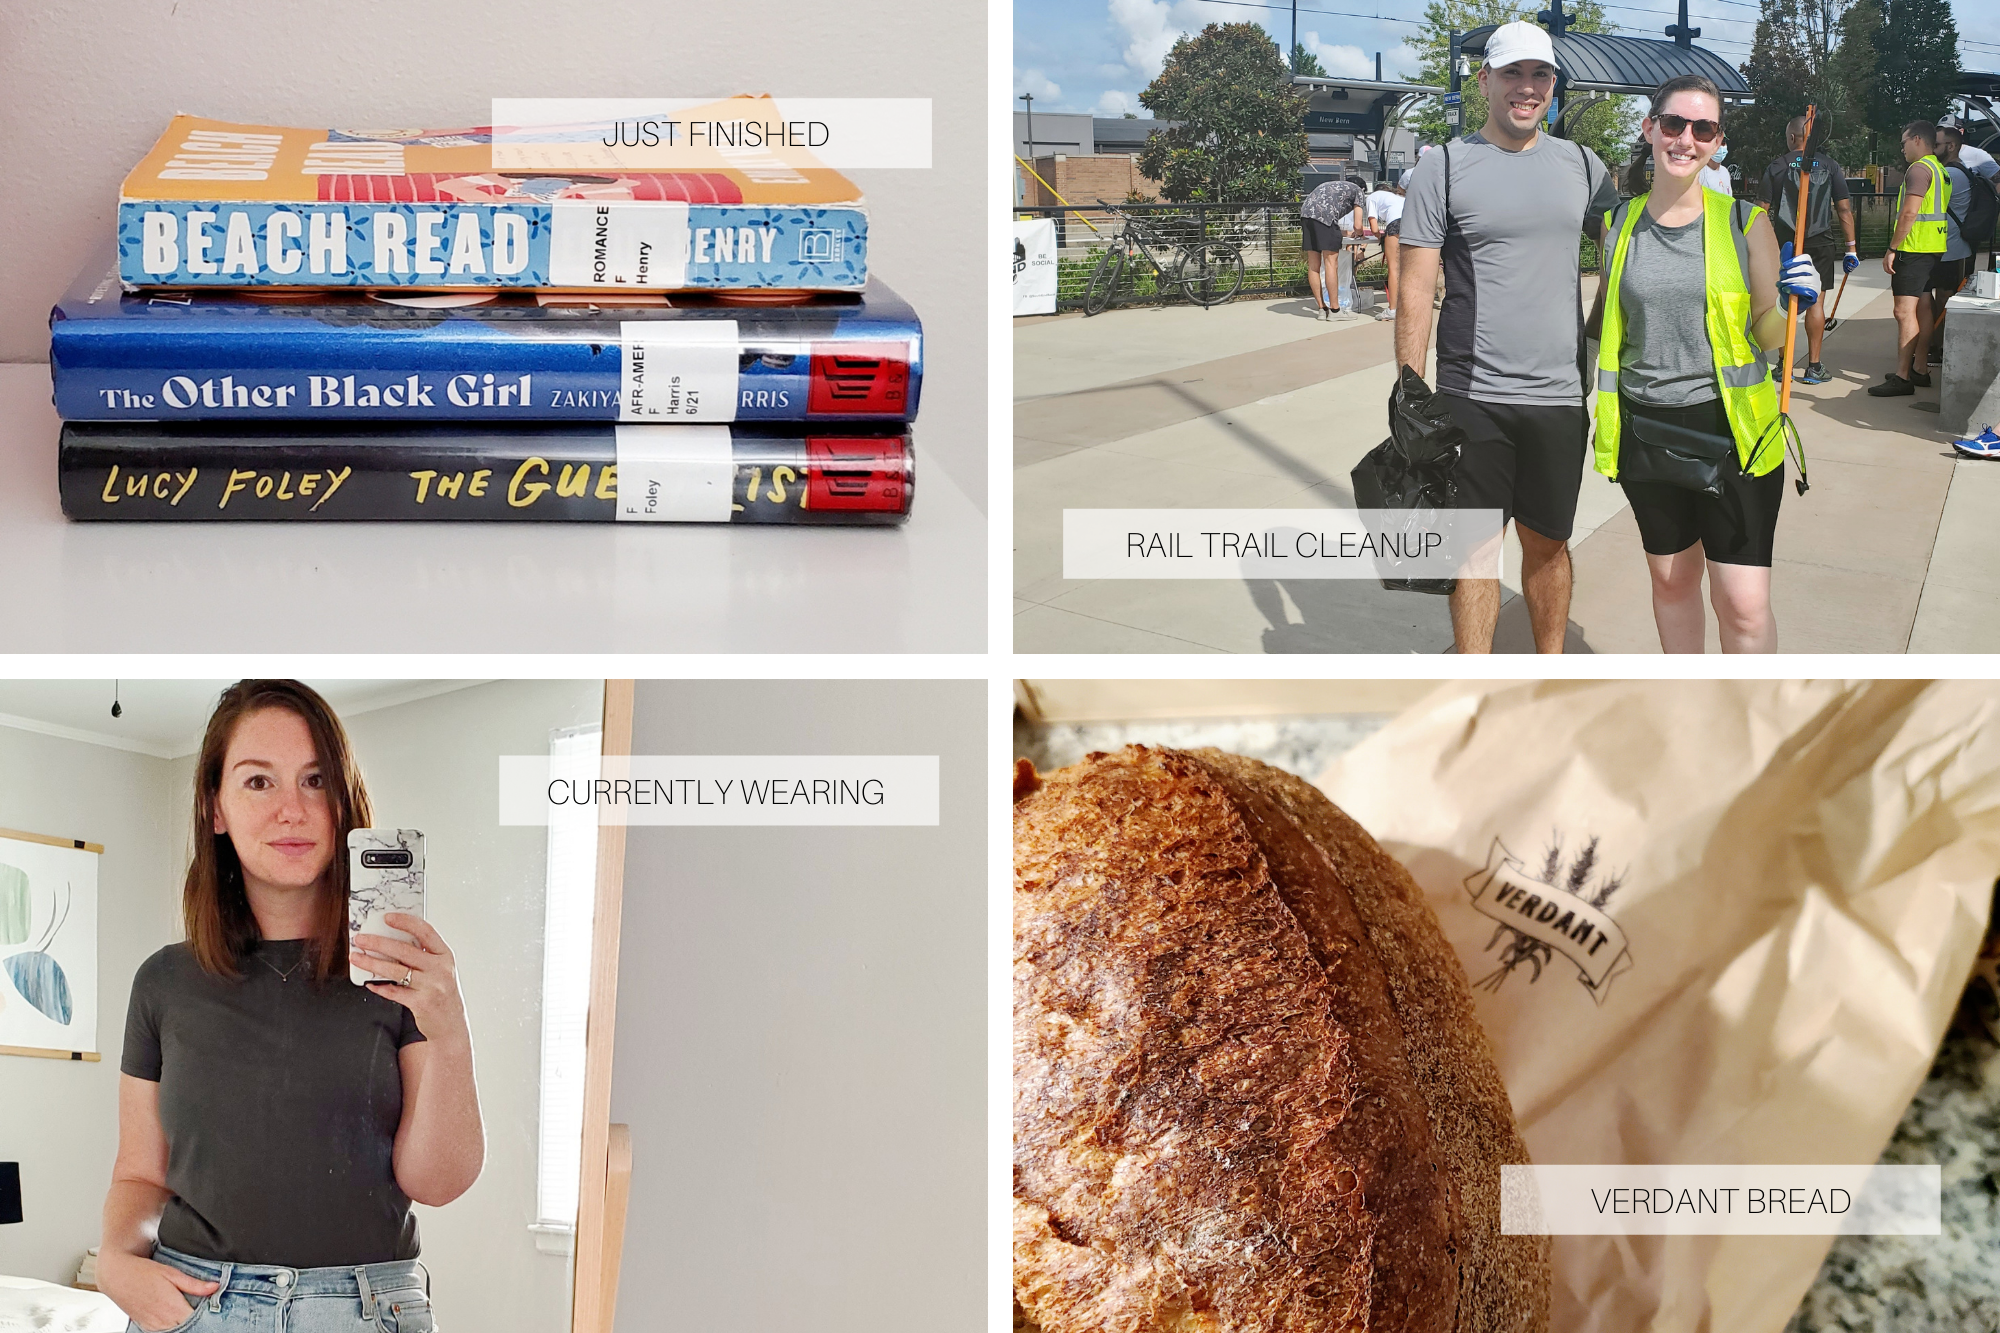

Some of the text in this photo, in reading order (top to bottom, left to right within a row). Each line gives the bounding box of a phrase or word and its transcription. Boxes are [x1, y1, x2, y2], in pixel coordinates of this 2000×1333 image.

[1319, 115, 1350, 124] New Bern
[157, 129, 406, 181] BEACH READ
[142, 211, 530, 275] BEACH READ
[593, 205, 610, 283] ROMANCE
[615, 275, 627, 284] F
[636, 241, 653, 284] Henry
[100, 373, 533, 409] The Other Black Girl
[550, 390, 790, 408] ZAKIYA RRIS
[666, 375, 681, 415] Harris
[686, 390, 699, 415] 6/21
[649, 407, 660, 415] F
[101, 464, 199, 507] LUCY
[218, 465, 353, 513] FOLEY
[408, 468, 493, 504] THE
[507, 456, 618, 509] GUE
[645, 479, 662, 514] Foley
[1495, 881, 1609, 957] VERDANT
